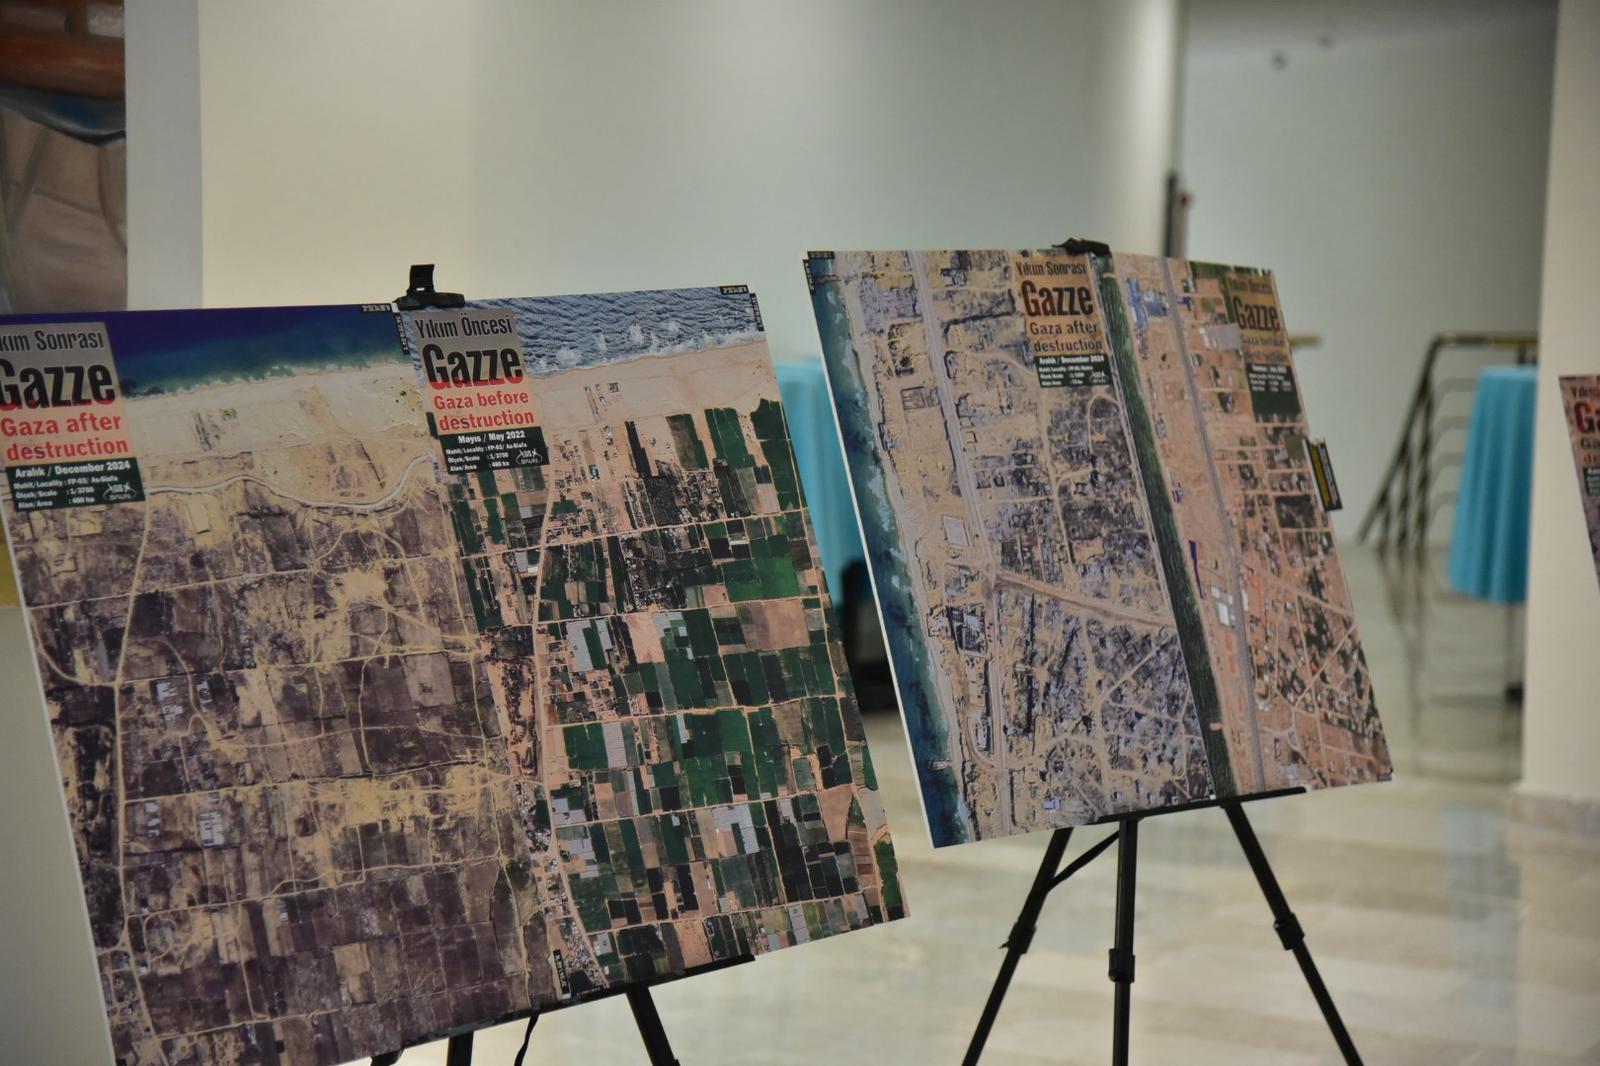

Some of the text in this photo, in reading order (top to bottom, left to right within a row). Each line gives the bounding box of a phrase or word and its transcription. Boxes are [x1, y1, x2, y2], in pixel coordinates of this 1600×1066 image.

[1016, 261, 1087, 276] Yıkım Sonrası
[1021, 280, 1094, 317] Gazze
[1232, 296, 1281, 331] Gazze
[415, 319, 459, 339] Yıkım
[460, 313, 513, 337] Öncesi
[1029, 320, 1098, 335] Gaza after
[34, 330, 105, 351] Sonrası
[1034, 339, 1103, 352] destruction
[422, 343, 524, 391] Gazze
[0, 358, 116, 411] Gazze
[434, 391, 529, 410] Gaza before
[1, 412, 122, 437] Gaza after
[439, 410, 535, 431] destruction
[458, 435, 482, 445] Mayıs
[488, 432, 505, 442] May
[506, 430, 525, 440] 2022
[6, 438, 129, 461] destruction
[15, 467, 46, 479] Aralık
[54, 463, 105, 475] December
[106, 460, 131, 471] 2024
